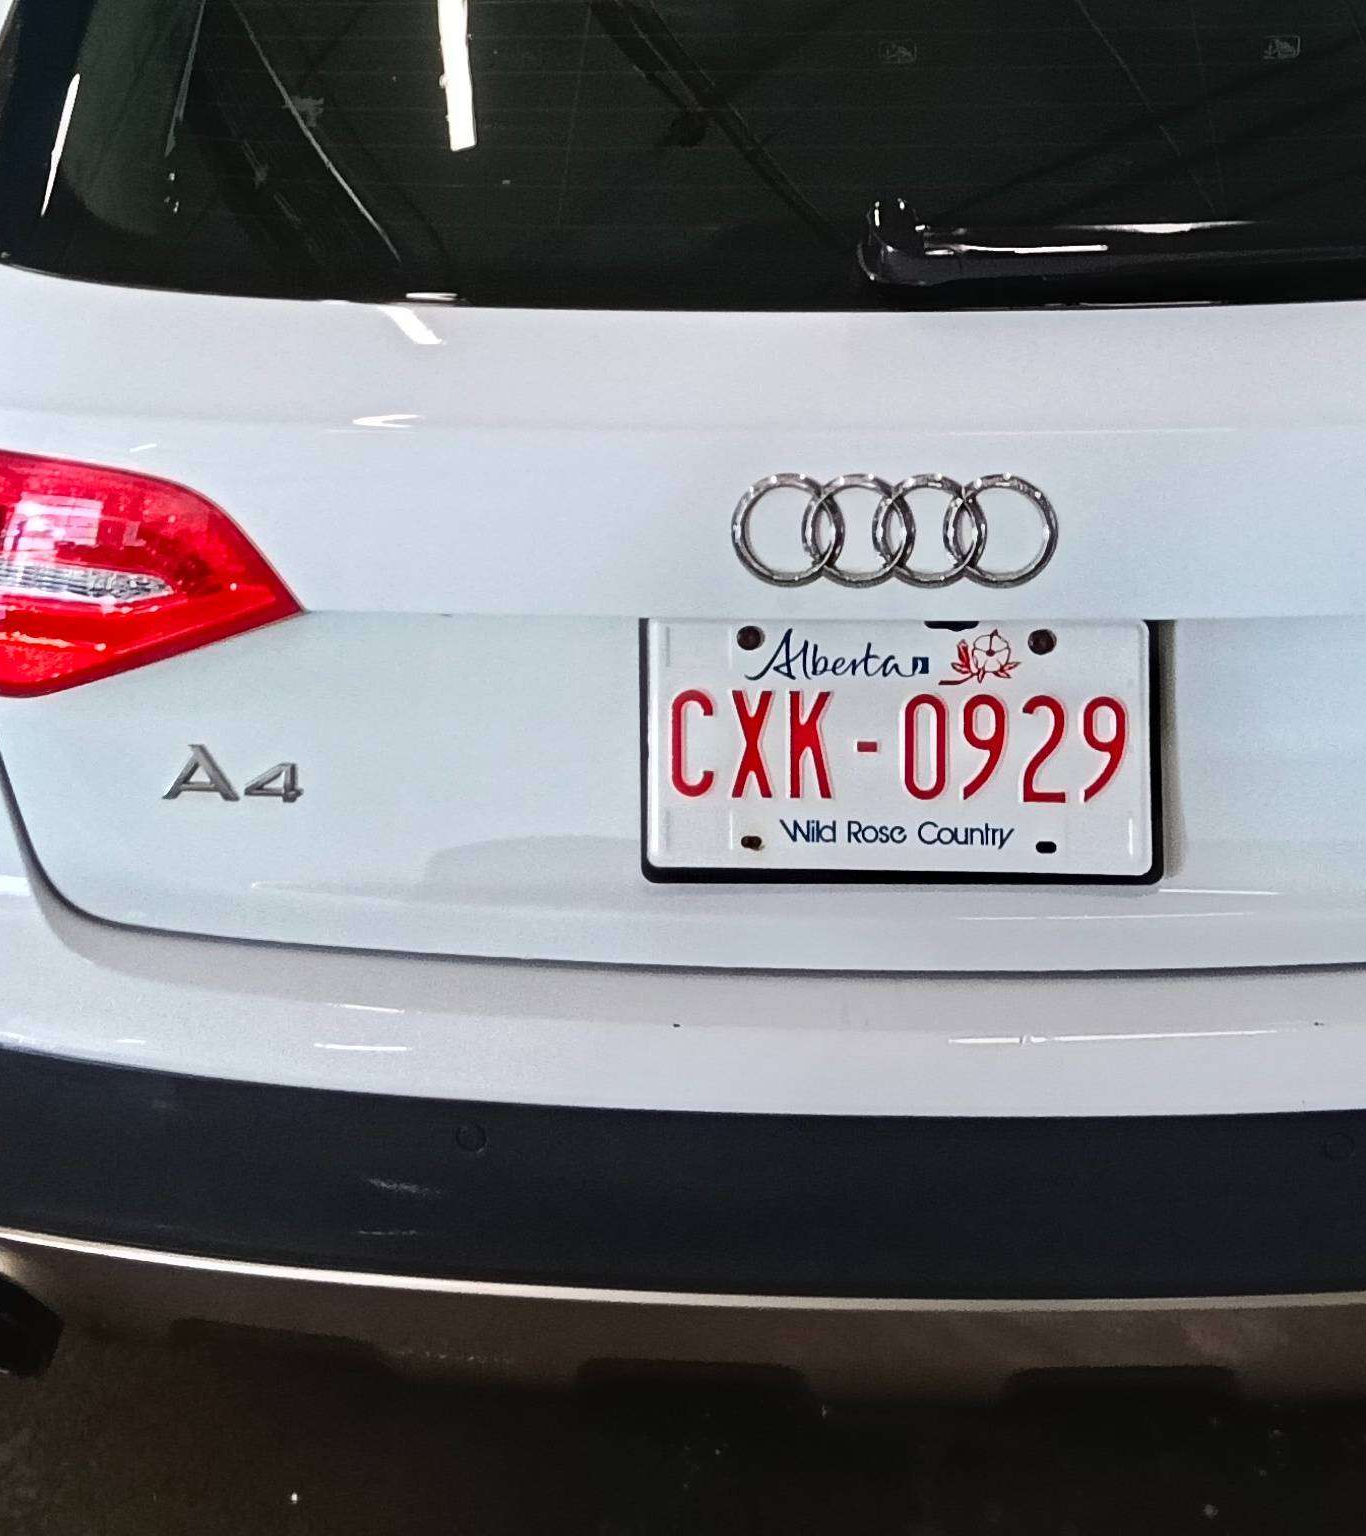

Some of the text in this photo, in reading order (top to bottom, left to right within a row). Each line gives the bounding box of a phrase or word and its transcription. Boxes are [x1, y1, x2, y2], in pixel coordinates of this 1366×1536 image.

[744, 628, 915, 680] Alberta
[162, 744, 304, 803] A4
[670, 689, 1129, 803] CXK-0929
[779, 818, 1014, 851] Wild Rose Country
